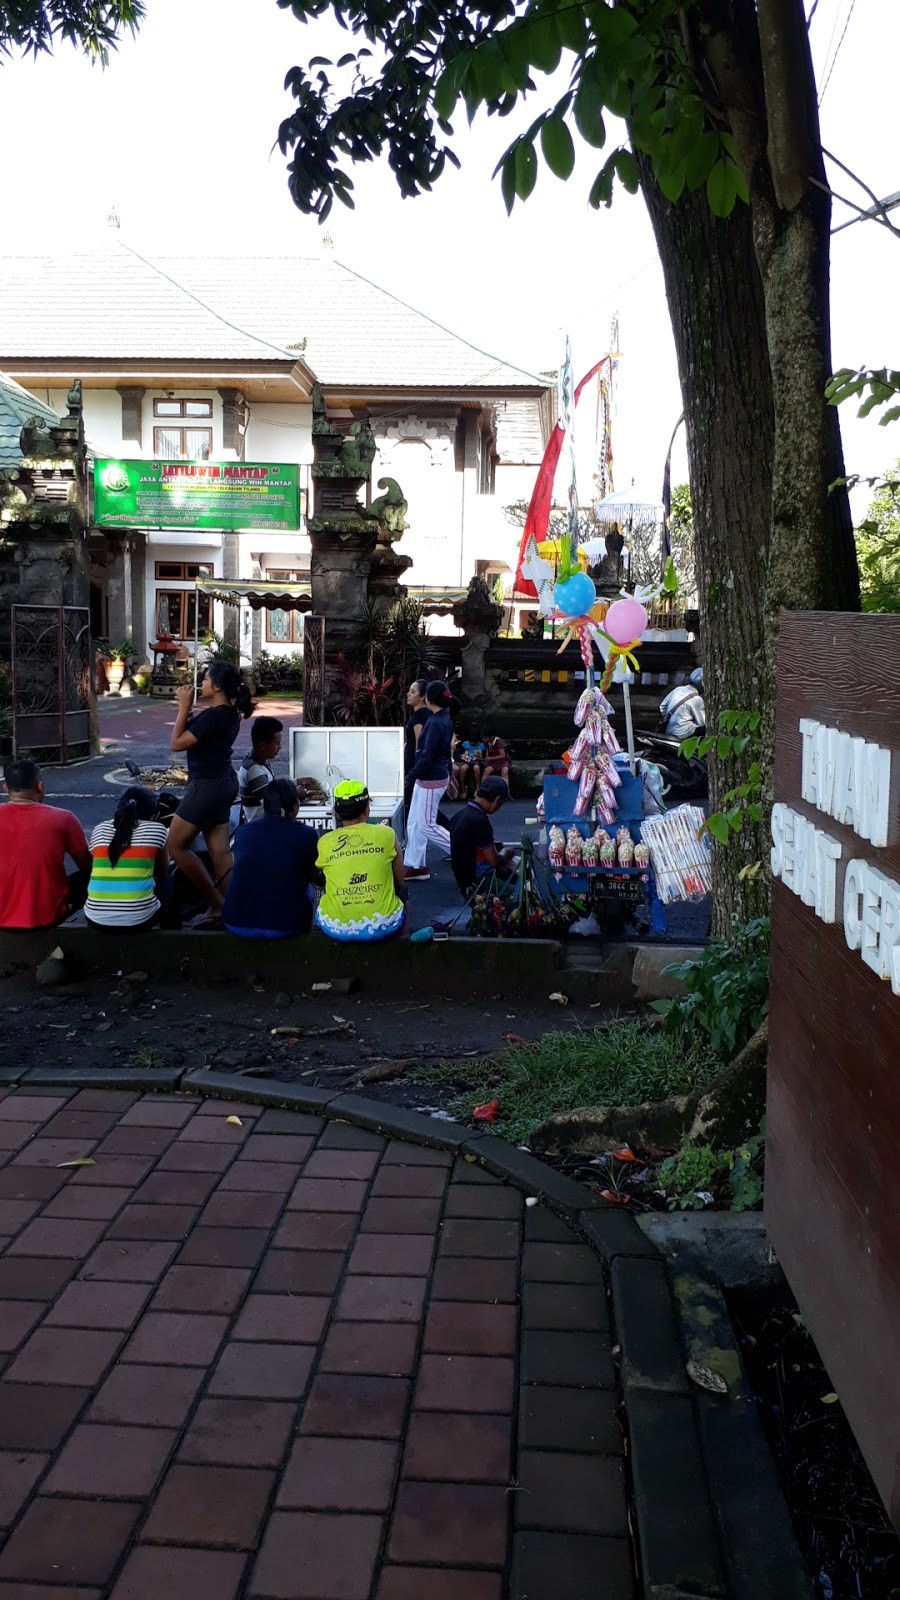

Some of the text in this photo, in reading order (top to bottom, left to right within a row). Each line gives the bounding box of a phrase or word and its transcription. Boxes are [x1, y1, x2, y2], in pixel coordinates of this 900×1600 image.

[223, 466, 269, 479] MANTAP
[799, 718, 891, 848] TAMAN
[770, 802, 842, 924] SEHAT
